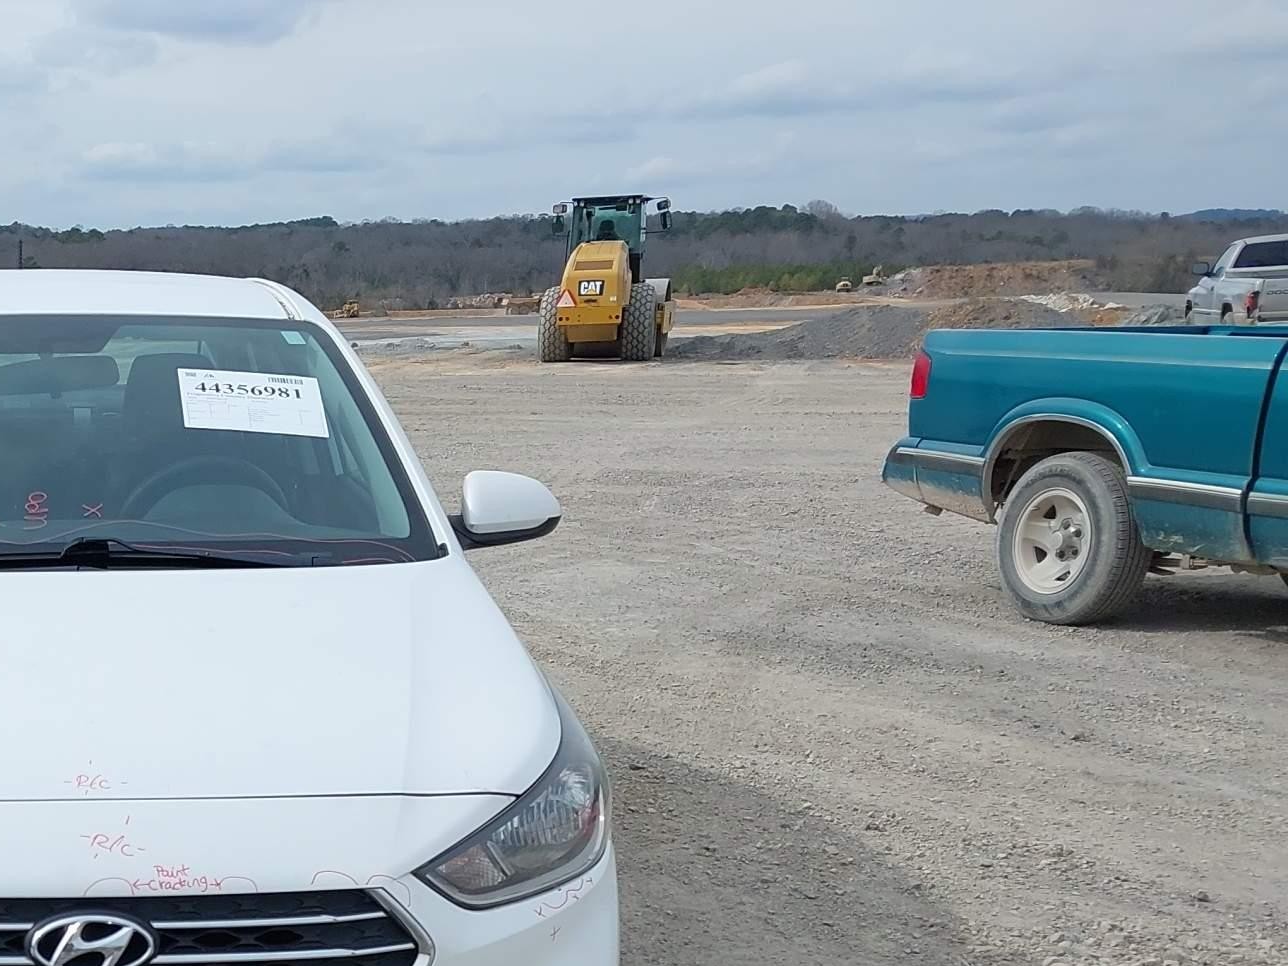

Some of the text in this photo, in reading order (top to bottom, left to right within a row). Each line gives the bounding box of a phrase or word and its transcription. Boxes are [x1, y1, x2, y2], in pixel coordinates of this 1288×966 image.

[580, 281, 603, 295] CAT
[194, 382, 302, 399] 44356981
[153, 864, 190, 878] Paint
